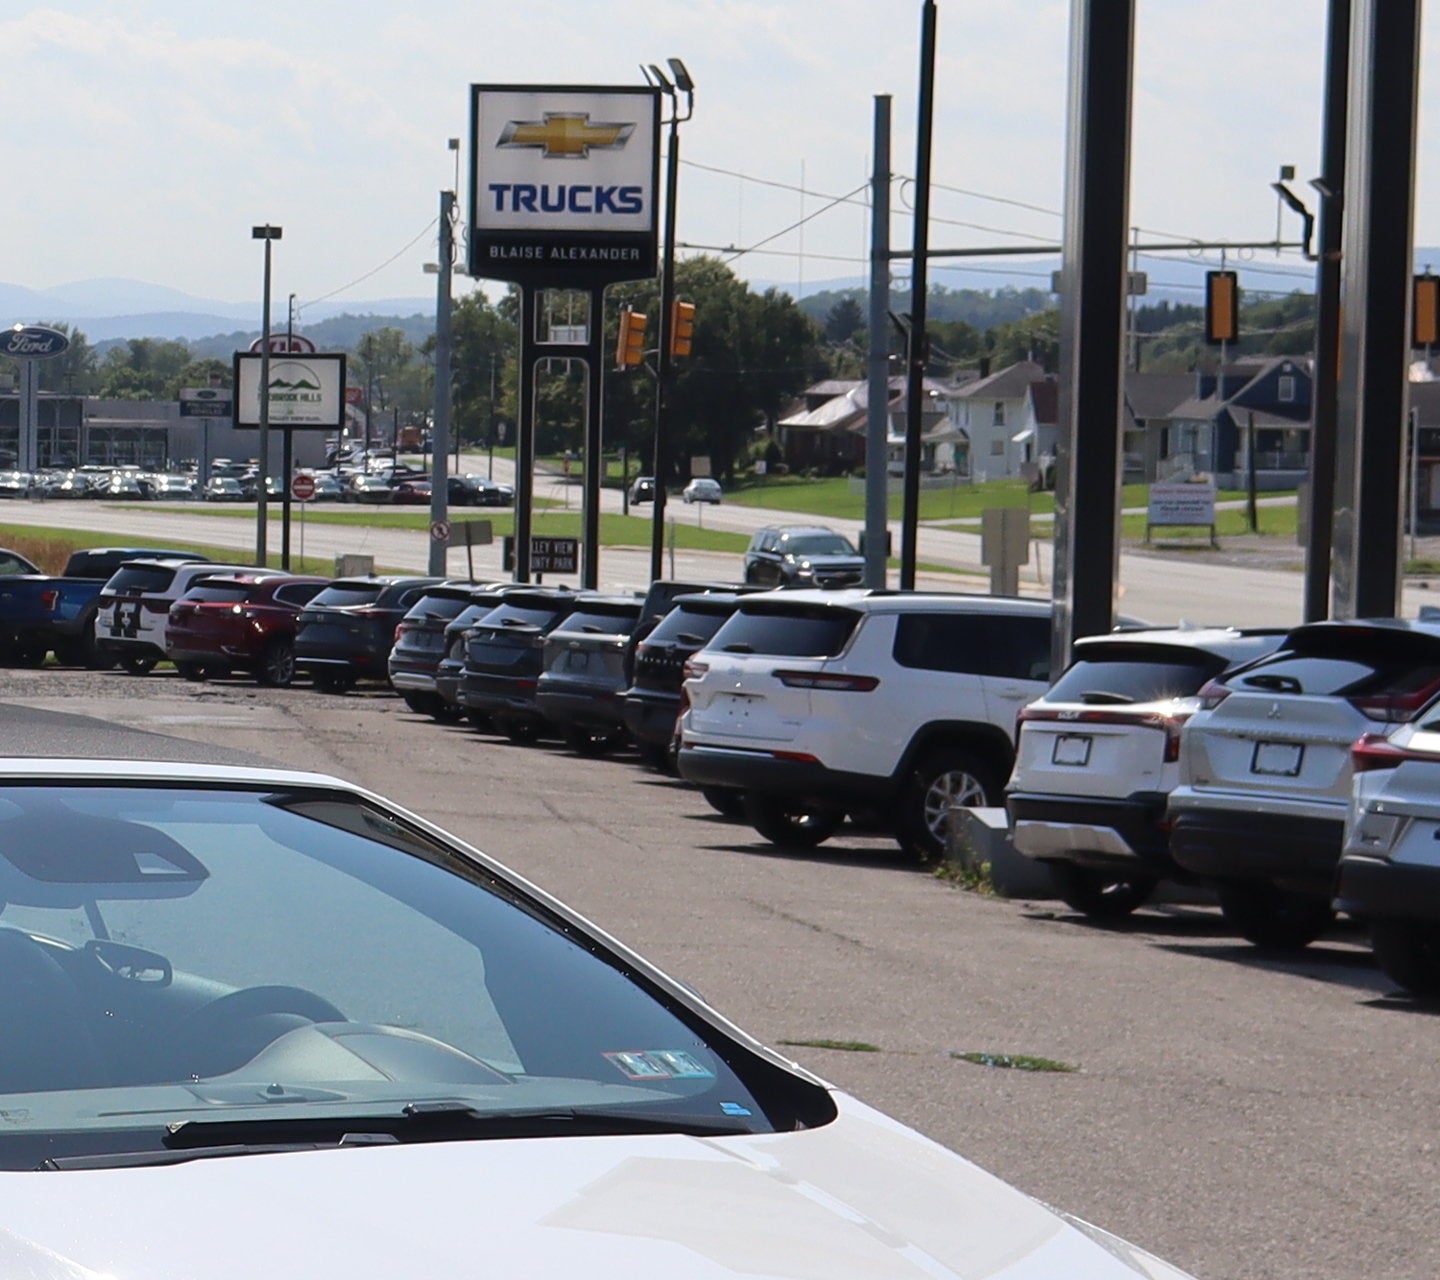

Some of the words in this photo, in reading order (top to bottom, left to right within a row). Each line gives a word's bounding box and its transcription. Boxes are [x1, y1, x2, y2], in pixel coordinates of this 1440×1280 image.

[488, 183, 643, 214] TRUCKS
[489, 245, 544, 260] BLAISE
[550, 246, 640, 261] ALEXANDER
[7, 332, 53, 353] Ford
